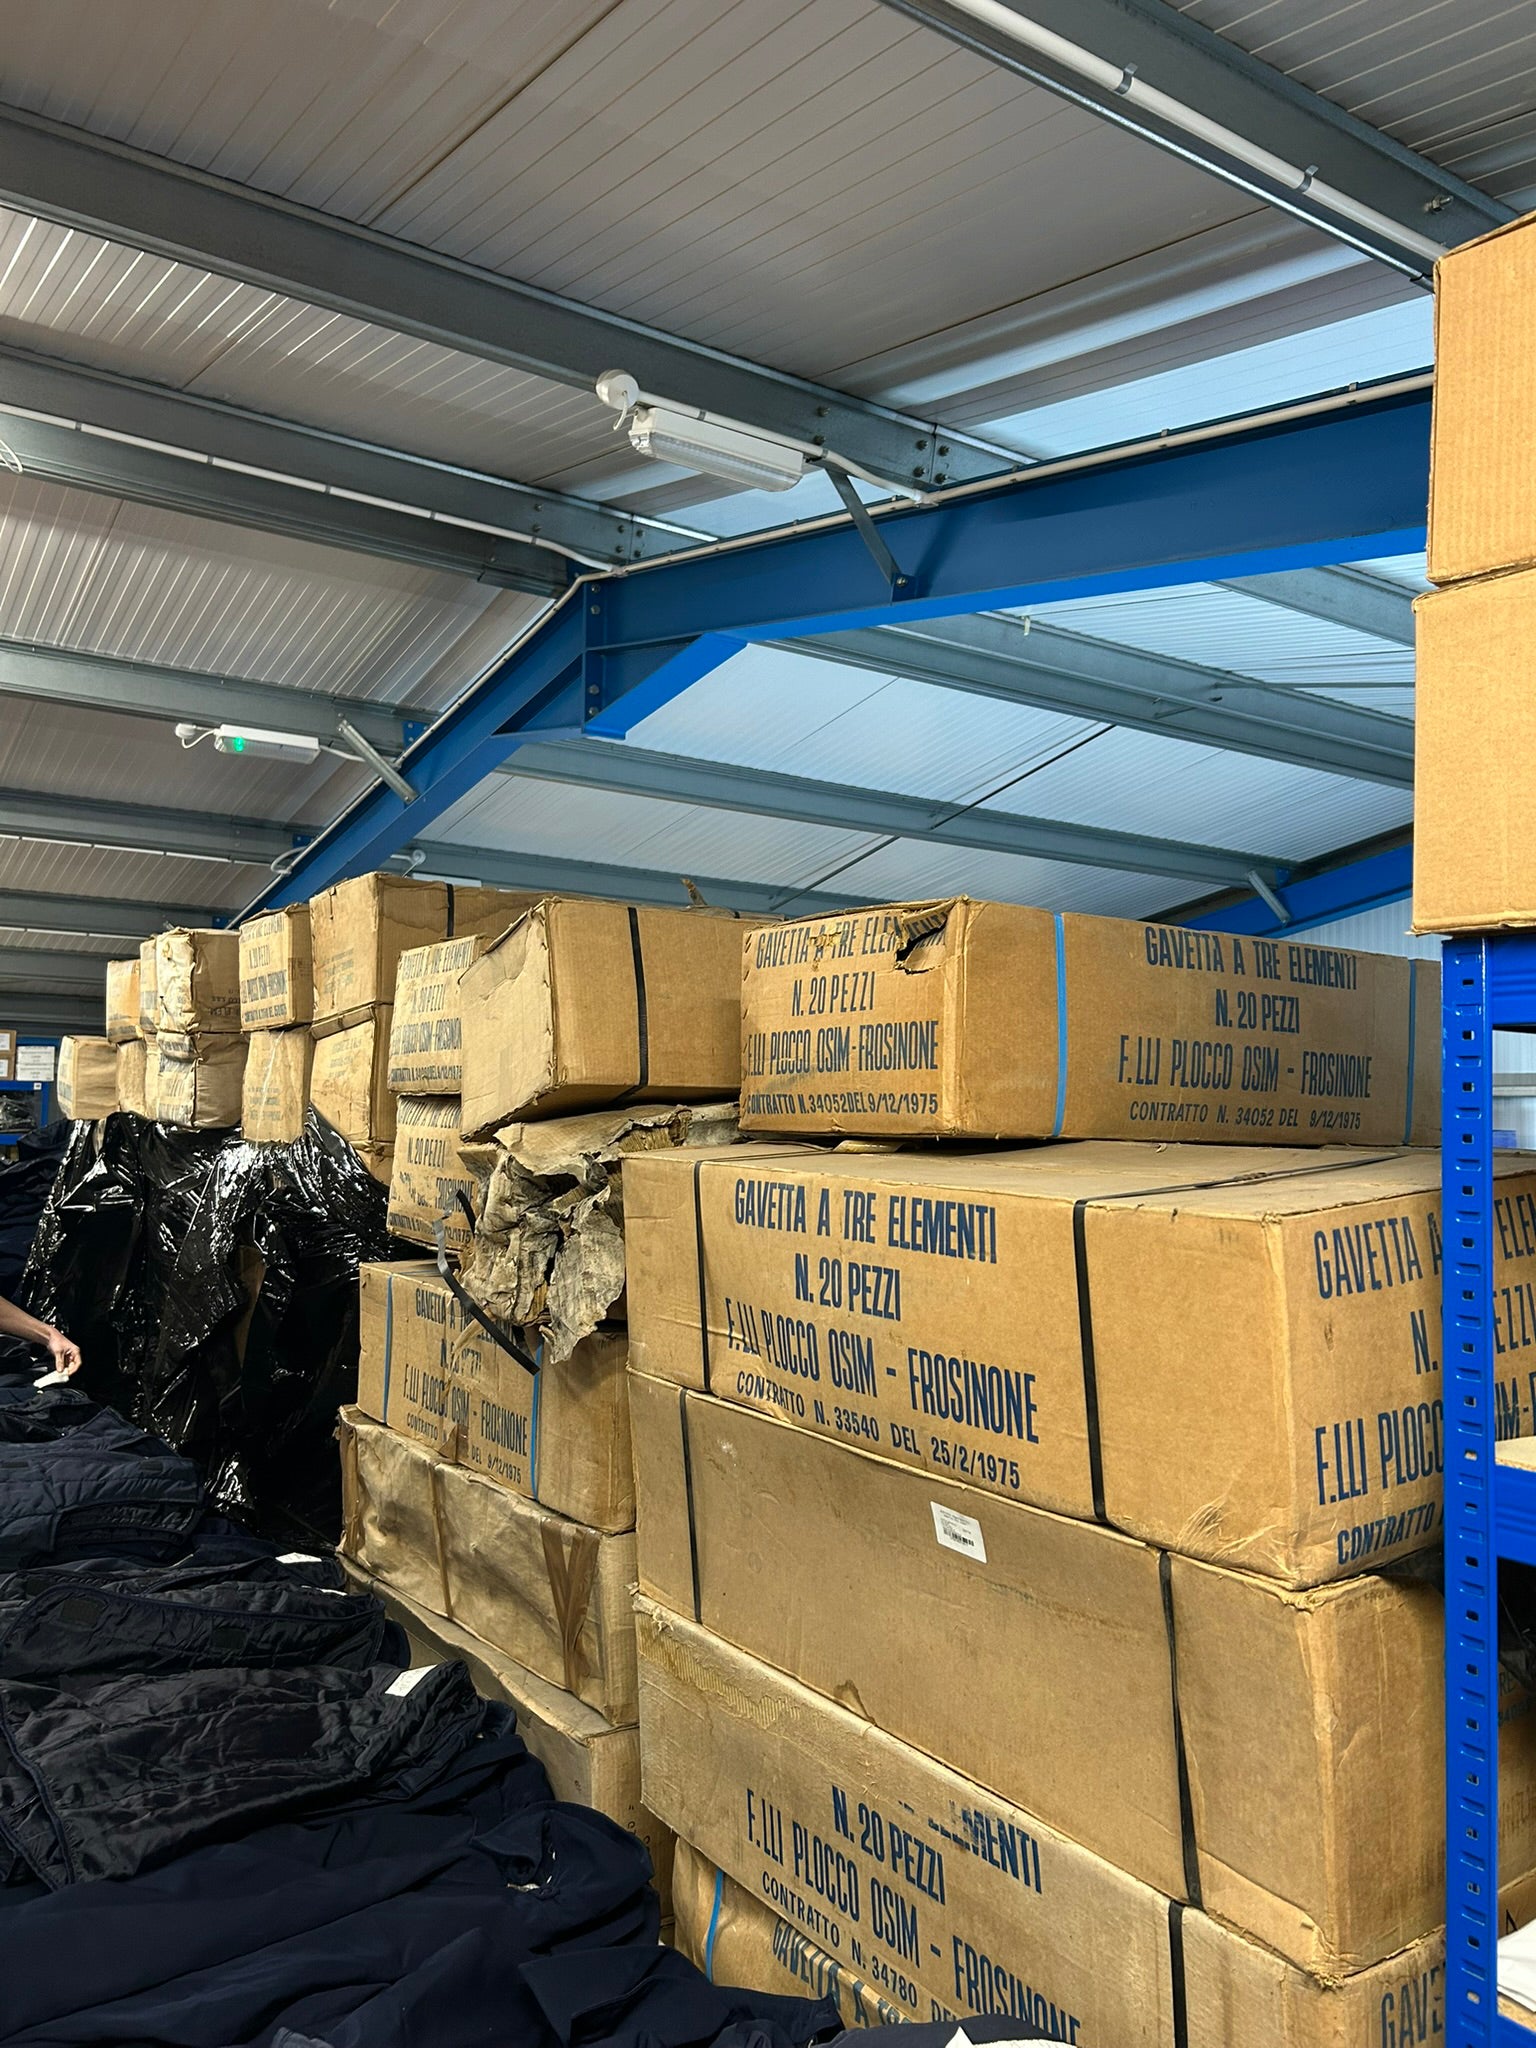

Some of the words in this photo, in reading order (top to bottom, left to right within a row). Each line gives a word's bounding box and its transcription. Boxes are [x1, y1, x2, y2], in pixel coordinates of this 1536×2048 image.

[756, 927, 811, 970] GAVETTA
[832, 918, 859, 960] TRE
[1145, 926, 1225, 973] GAVETTA
[1233, 938, 1246, 975] A
[1253, 940, 1281, 980] TRE
[1288, 945, 1358, 990] ELEMENTI
[792, 978, 804, 1016] N.
[808, 975, 827, 1015] 20
[830, 971, 876, 1014] PEZZI
[1215, 988, 1233, 1028] N.
[1237, 991, 1257, 1030] 20
[1261, 994, 1300, 1034] PEZZI
[770, 1028, 811, 1075] PLOCCO
[1118, 1034, 1161, 1086] F.LLI
[1170, 1039, 1233, 1090] PLOCCO
[1241, 1045, 1279, 1092] OSIM
[1301, 1050, 1373, 1098] FROSINONE
[747, 1093, 796, 1116] CONTRATTO
[1129, 1100, 1208, 1123] CONTRATTO
[1216, 1104, 1229, 1124] N.
[1235, 1107, 1274, 1127] 34052
[1279, 1108, 1299, 1127] DEL
[1309, 1110, 1361, 1130] 9/12/1975
[735, 1178, 806, 1234] GAVETTA
[817, 1188, 830, 1237] A
[843, 1189, 876, 1244] TRE
[887, 1195, 997, 1265] ELEMENTI
[795, 1252, 814, 1302] N.
[819, 1256, 843, 1308] 20
[848, 1262, 901, 1321] PEZZI
[1313, 1215, 1424, 1300] GAVETTA
[1410, 1308, 1439, 1375] N.
[1493, 1283, 1536, 1354] EZZI
[725, 1297, 760, 1355] F.LLI
[761, 1309, 820, 1382] PLOCCO
[828, 1329, 878, 1398] OSIM
[907, 1348, 1039, 1445] FROSINONE
[481, 1399, 528, 1457] FROSINONE
[736, 1369, 806, 1418] CONTRATTO
[814, 1400, 831, 1428] N.
[834, 1408, 880, 1442] 33540
[890, 1422, 921, 1456] DEL
[931, 1436, 1021, 1491] 25/2/1975
[1314, 1417, 1368, 1506] F.LLI
[1378, 1399, 1444, 1489] PLOCC
[1337, 1500, 1432, 1566] CONTRATTO
[747, 1788, 784, 1867] F.LLI
[792, 1820, 860, 1922] PLOCCO
[871, 1877, 921, 1969] OSIM
[832, 1784, 855, 1843] N.
[858, 1802, 885, 1863] 20
[888, 1821, 946, 1906] PEZZI
[762, 1871, 840, 1948] CONTRATTO
[851, 1937, 867, 1970] N.
[871, 1955, 918, 2009] 34780
[931, 1998, 957, 2022] DE
[853, 1980, 870, 2028] A
[1381, 1962, 1446, 2048] GAVE
